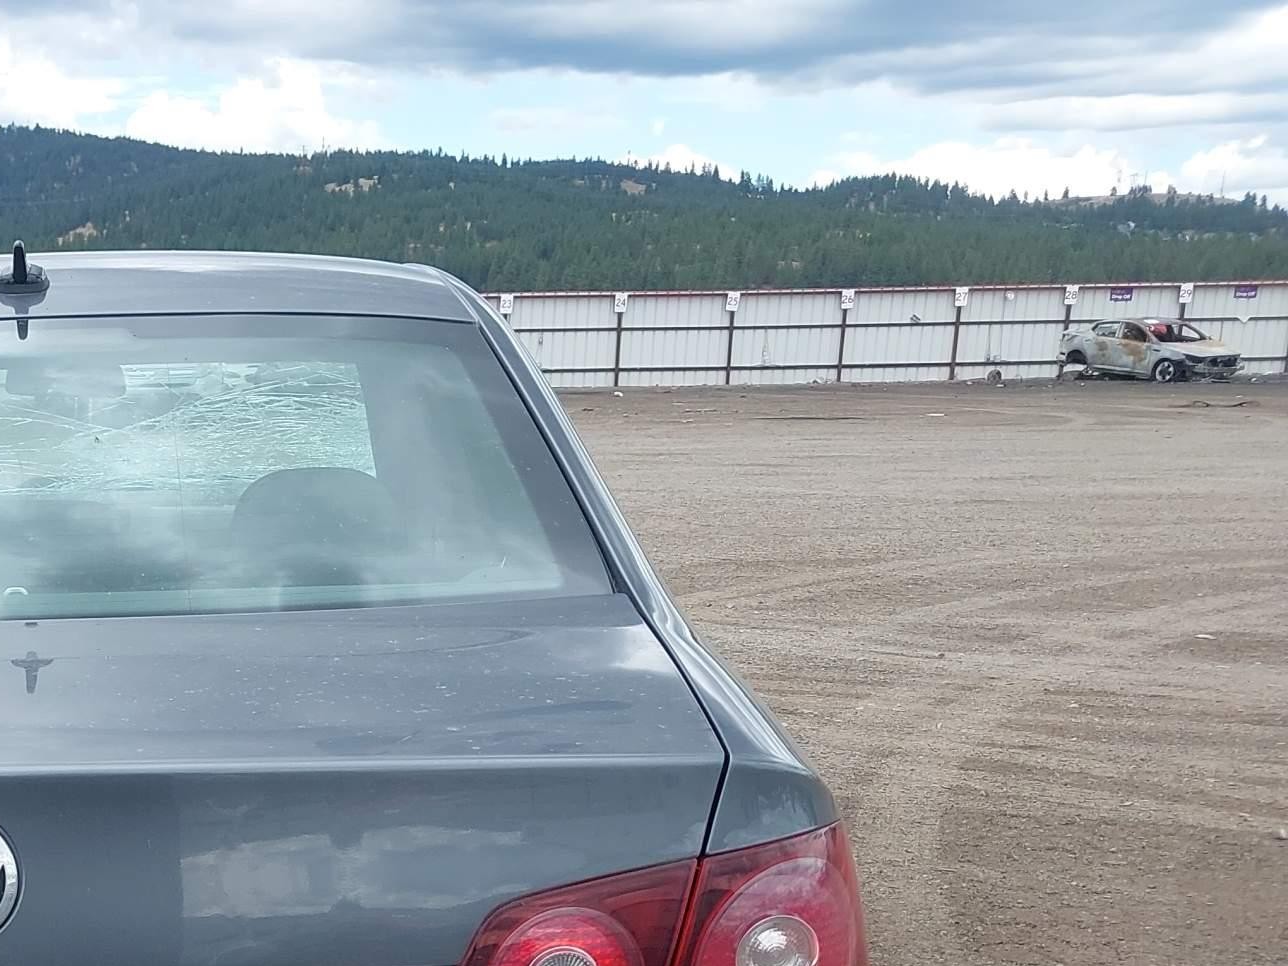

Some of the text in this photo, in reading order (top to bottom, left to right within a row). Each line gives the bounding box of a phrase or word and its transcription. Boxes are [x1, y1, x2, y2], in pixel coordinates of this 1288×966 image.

[956, 292, 967, 302] 27
[1065, 290, 1078, 300] 28
[1180, 288, 1192, 298] 29
[501, 299, 512, 309] 23
[615, 297, 626, 307] 24
[728, 296, 739, 306] 25
[842, 294, 853, 304] 26
